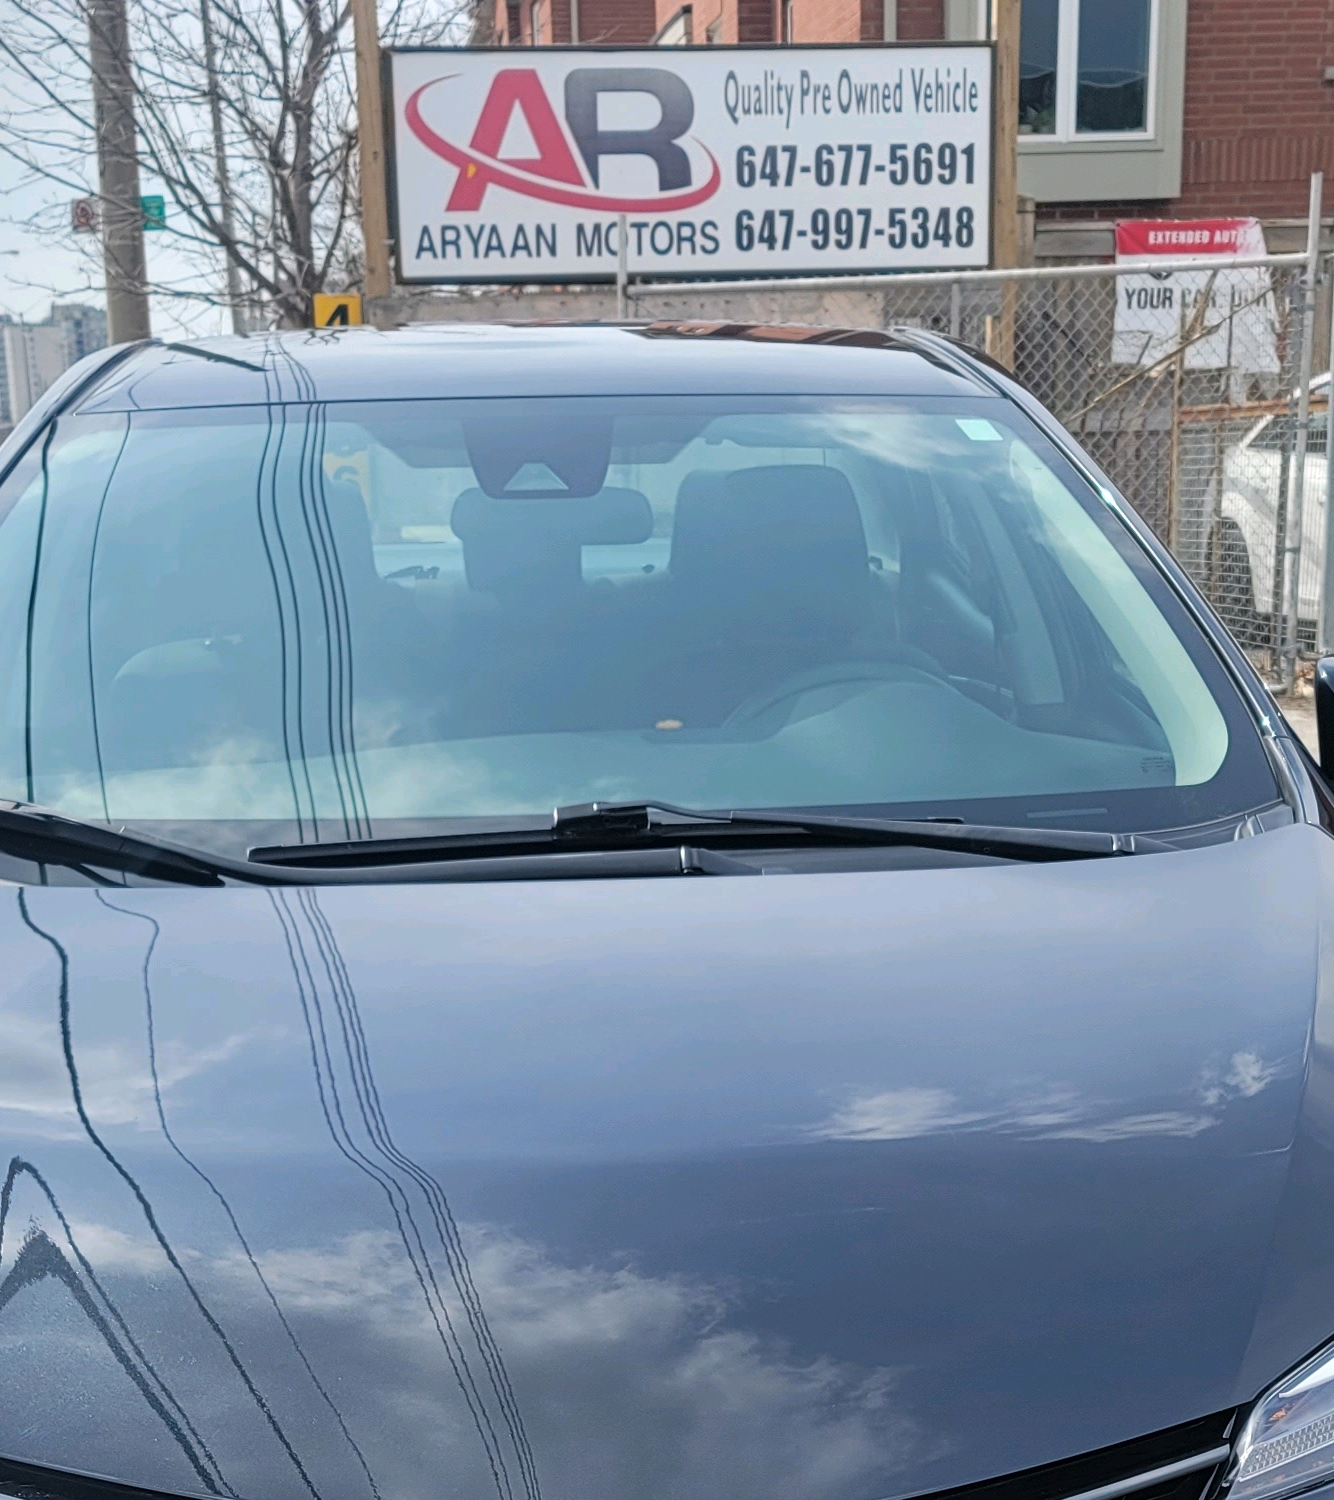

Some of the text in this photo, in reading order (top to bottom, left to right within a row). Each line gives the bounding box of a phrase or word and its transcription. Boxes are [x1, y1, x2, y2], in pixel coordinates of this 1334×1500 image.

[724, 68, 979, 129] Quality Pre Owned Vehicle
[735, 142, 976, 188] 647-677-5691
[415, 220, 720, 261] ARYAAN MOTORS
[734, 206, 976, 252] 647-997-5348
[1148, 229, 1210, 245] EXTENDED
[1125, 286, 1174, 310] YOUR
